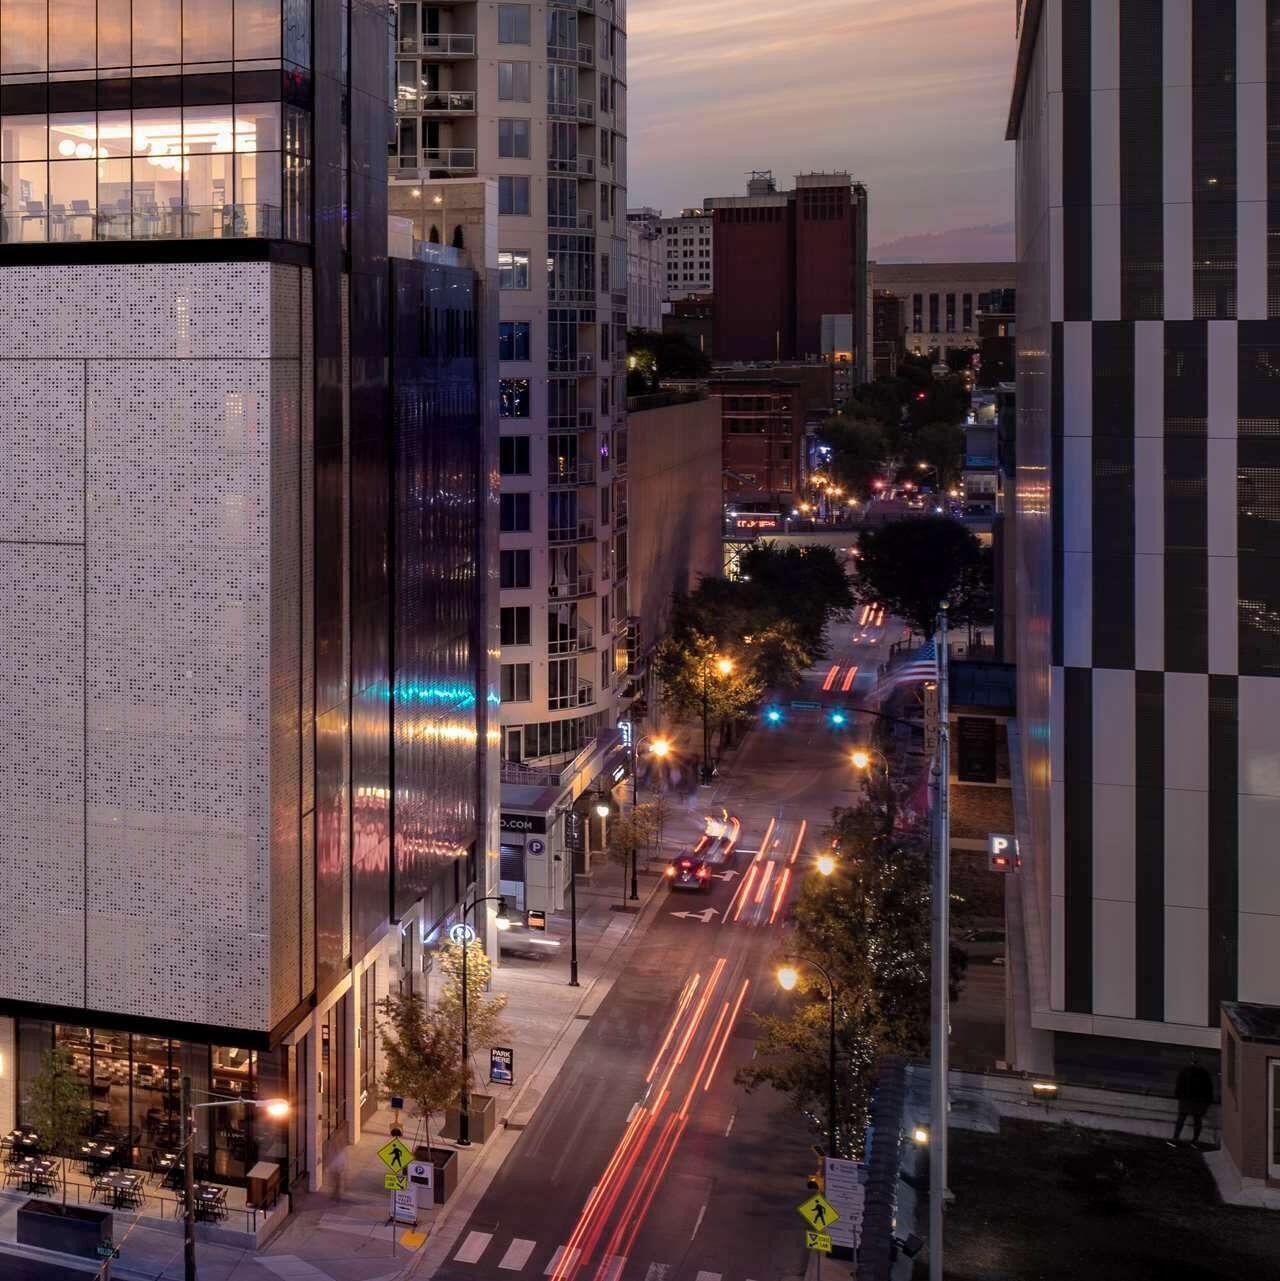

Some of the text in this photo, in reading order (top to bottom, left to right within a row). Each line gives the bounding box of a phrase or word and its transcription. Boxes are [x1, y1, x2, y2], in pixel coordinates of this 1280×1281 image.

[992, 837, 1008, 854] P
[492, 1049, 511, 1058] PARK
[492, 1055, 511, 1064] HERE
